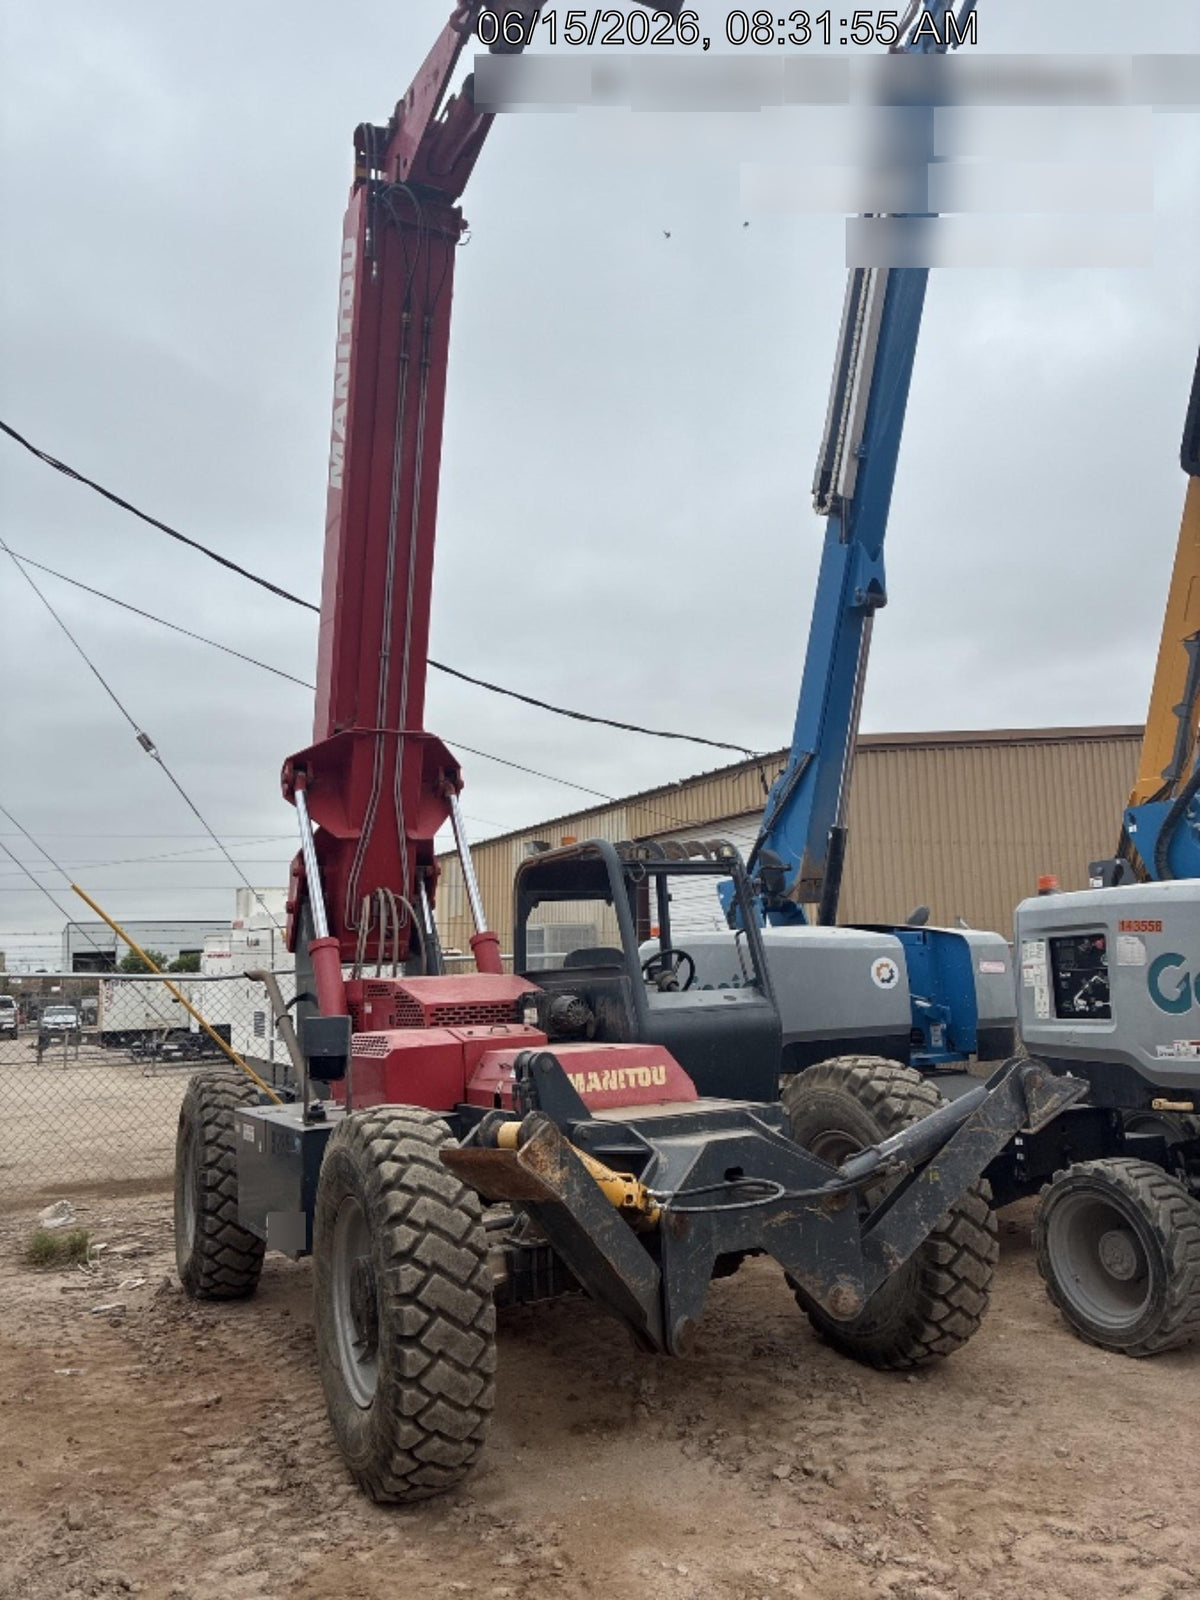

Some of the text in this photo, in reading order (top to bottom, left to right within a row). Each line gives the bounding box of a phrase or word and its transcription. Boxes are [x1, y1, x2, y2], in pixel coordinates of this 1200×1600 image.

[328, 236, 358, 489] MANITOU
[1147, 952, 1200, 1015] G
[567, 1065, 667, 1094] MANITOU
